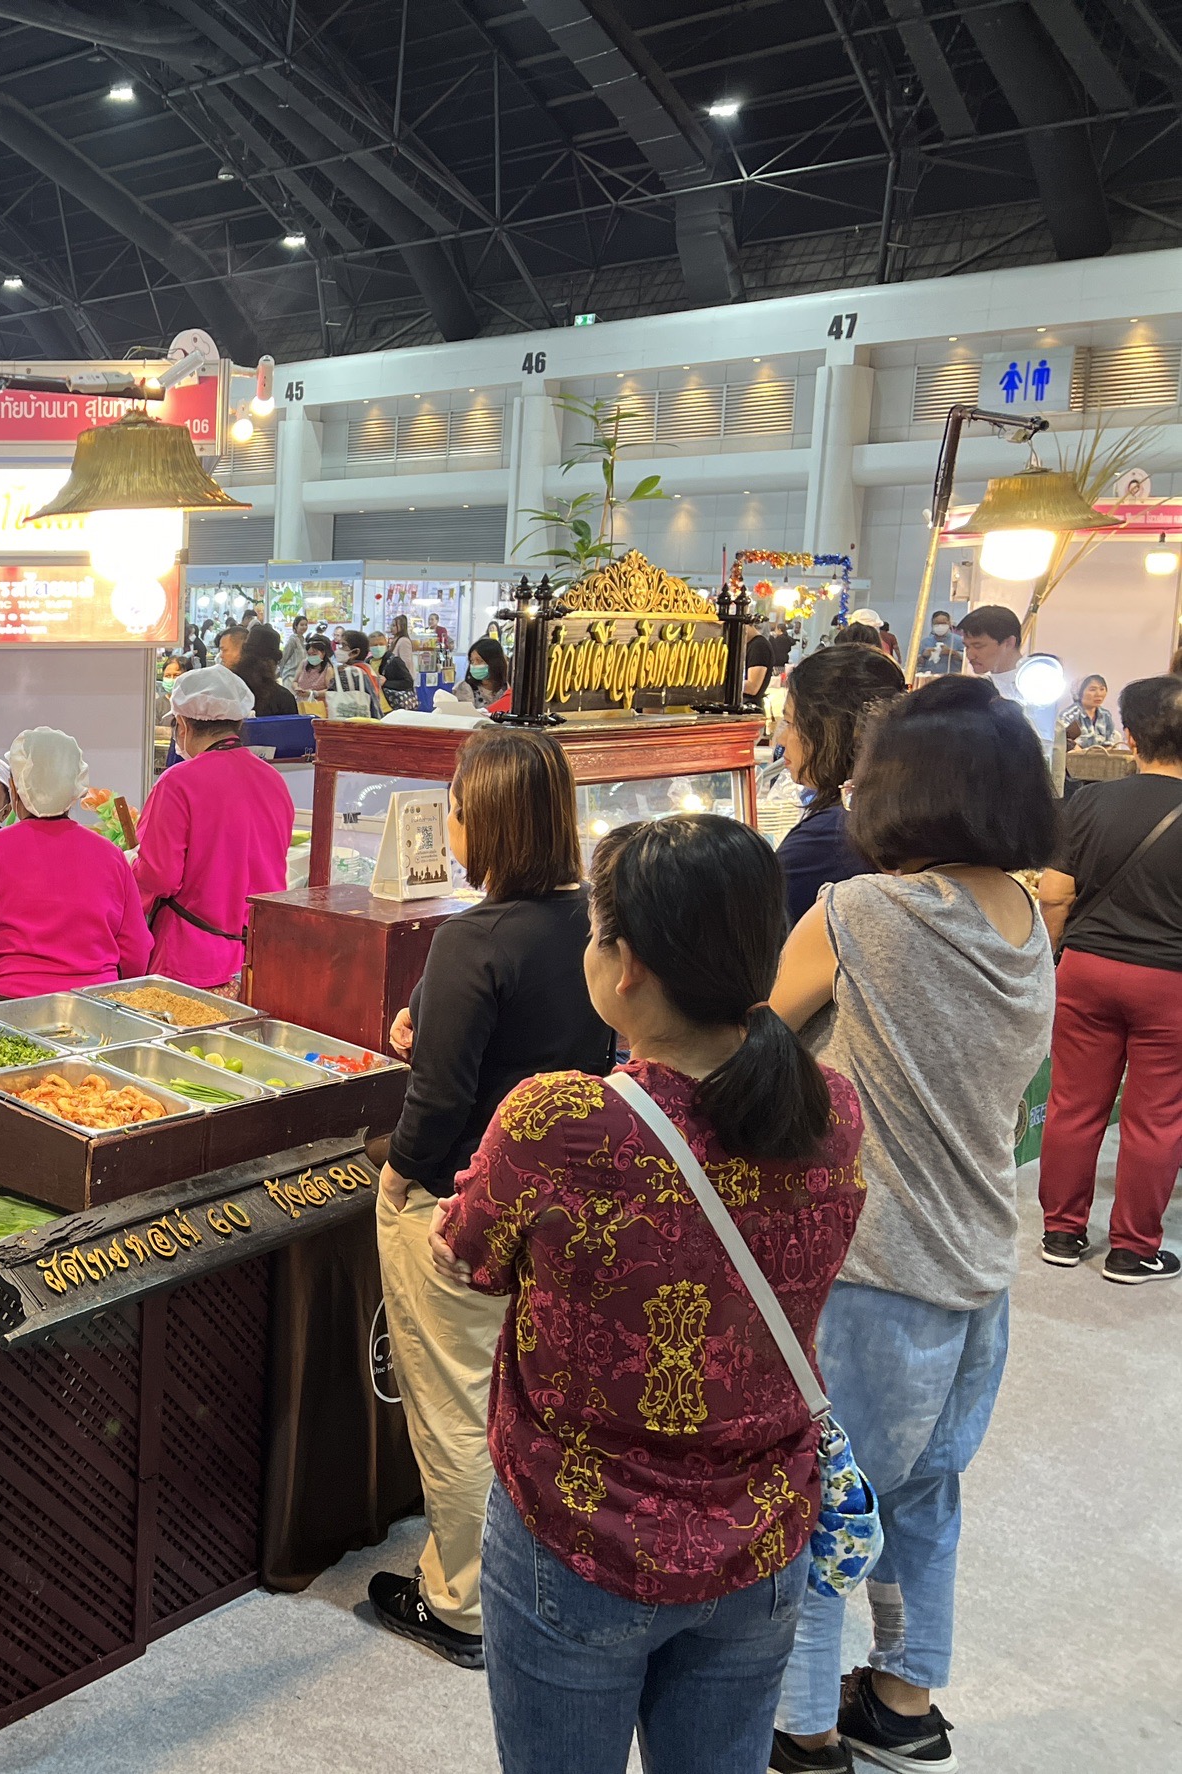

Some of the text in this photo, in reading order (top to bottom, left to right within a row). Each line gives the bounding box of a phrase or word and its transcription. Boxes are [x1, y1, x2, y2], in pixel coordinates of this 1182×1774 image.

[827, 313, 858, 340] 47
[521, 352, 546, 374] 46
[285, 381, 304, 401] 45
[206, 1201, 252, 1235] 60
[328, 1162, 372, 1191] 80
